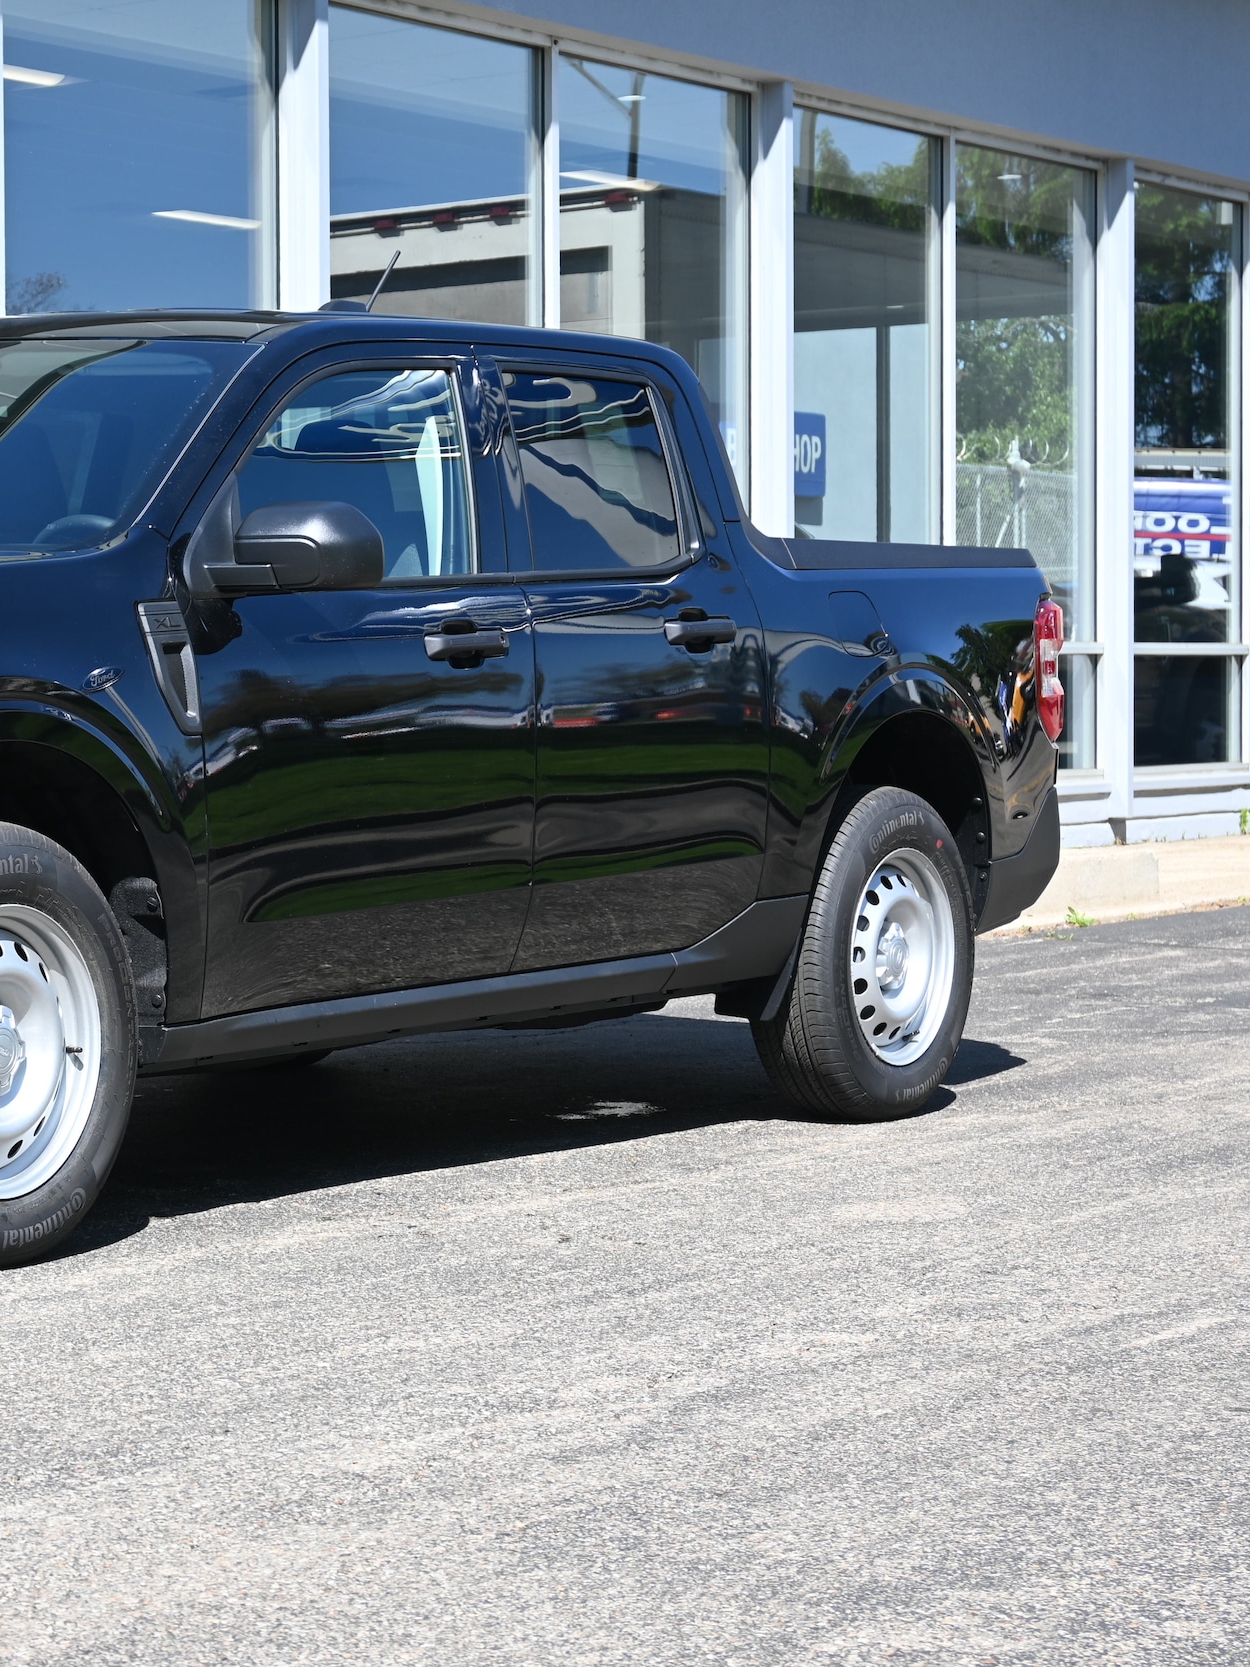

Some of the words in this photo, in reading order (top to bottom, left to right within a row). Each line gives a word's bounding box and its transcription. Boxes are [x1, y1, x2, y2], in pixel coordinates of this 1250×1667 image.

[154, 616, 181, 629] XL
[90, 670, 116, 687] Ford
[869, 811, 918, 854] Continental
[903, 1057, 948, 1101] Continental
[2, 1187, 87, 1250] Continental
